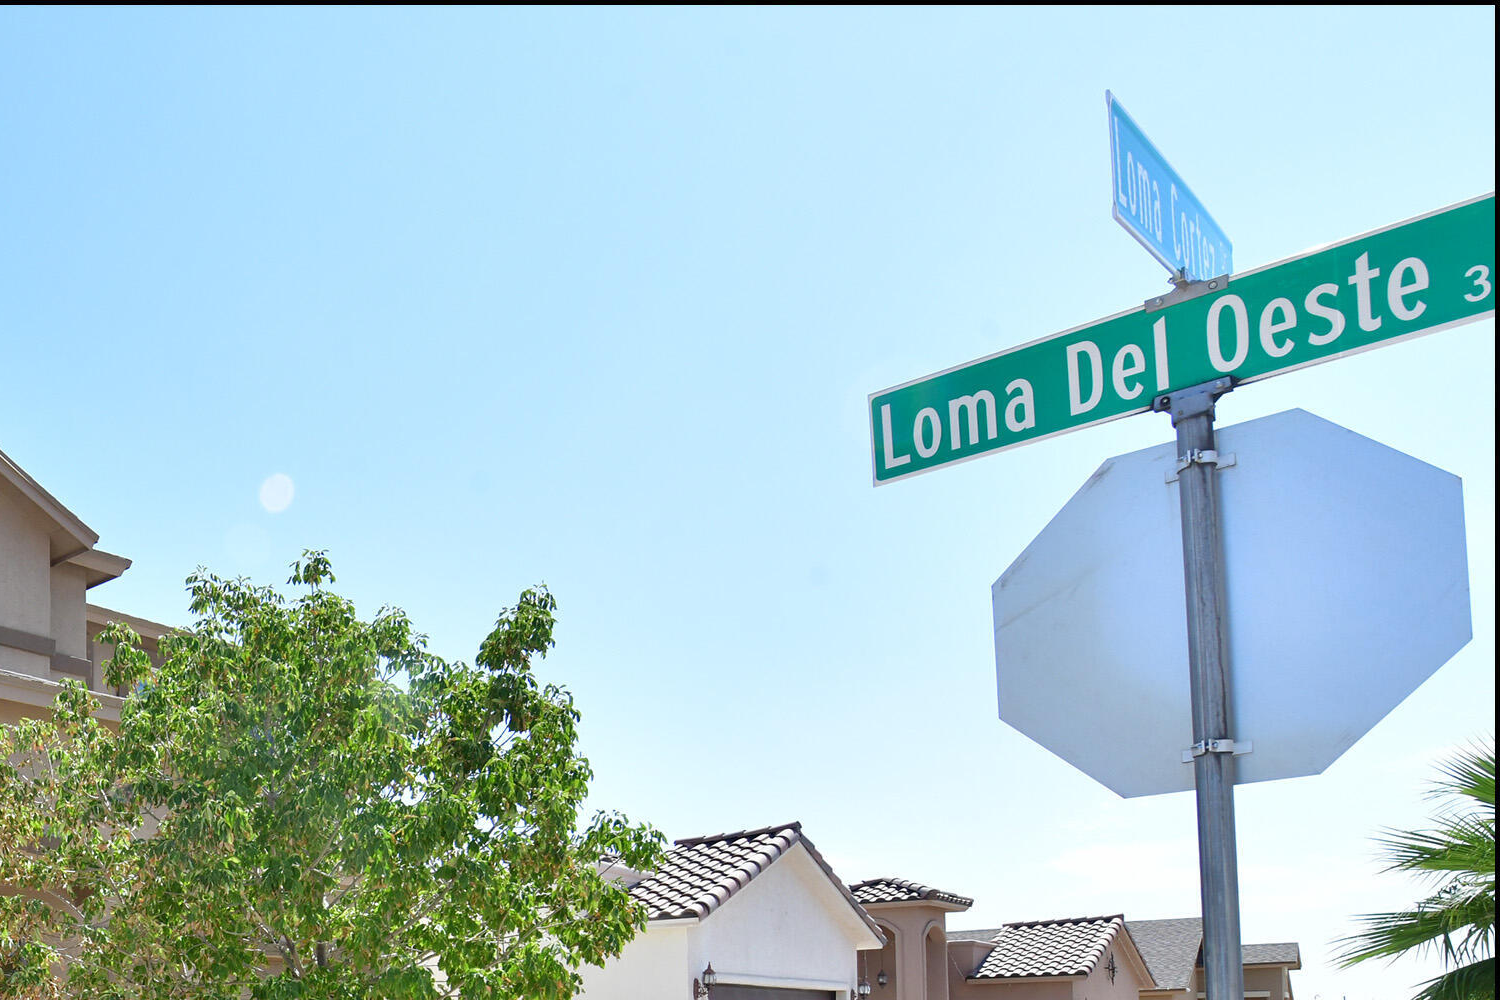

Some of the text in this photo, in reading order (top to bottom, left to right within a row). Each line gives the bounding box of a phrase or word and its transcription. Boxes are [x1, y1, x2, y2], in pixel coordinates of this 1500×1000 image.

[1114, 116, 1162, 244] Loma
[880, 378, 1036, 470] Loma
[1065, 315, 1170, 417] Del
[1206, 251, 1430, 373] Oeste
